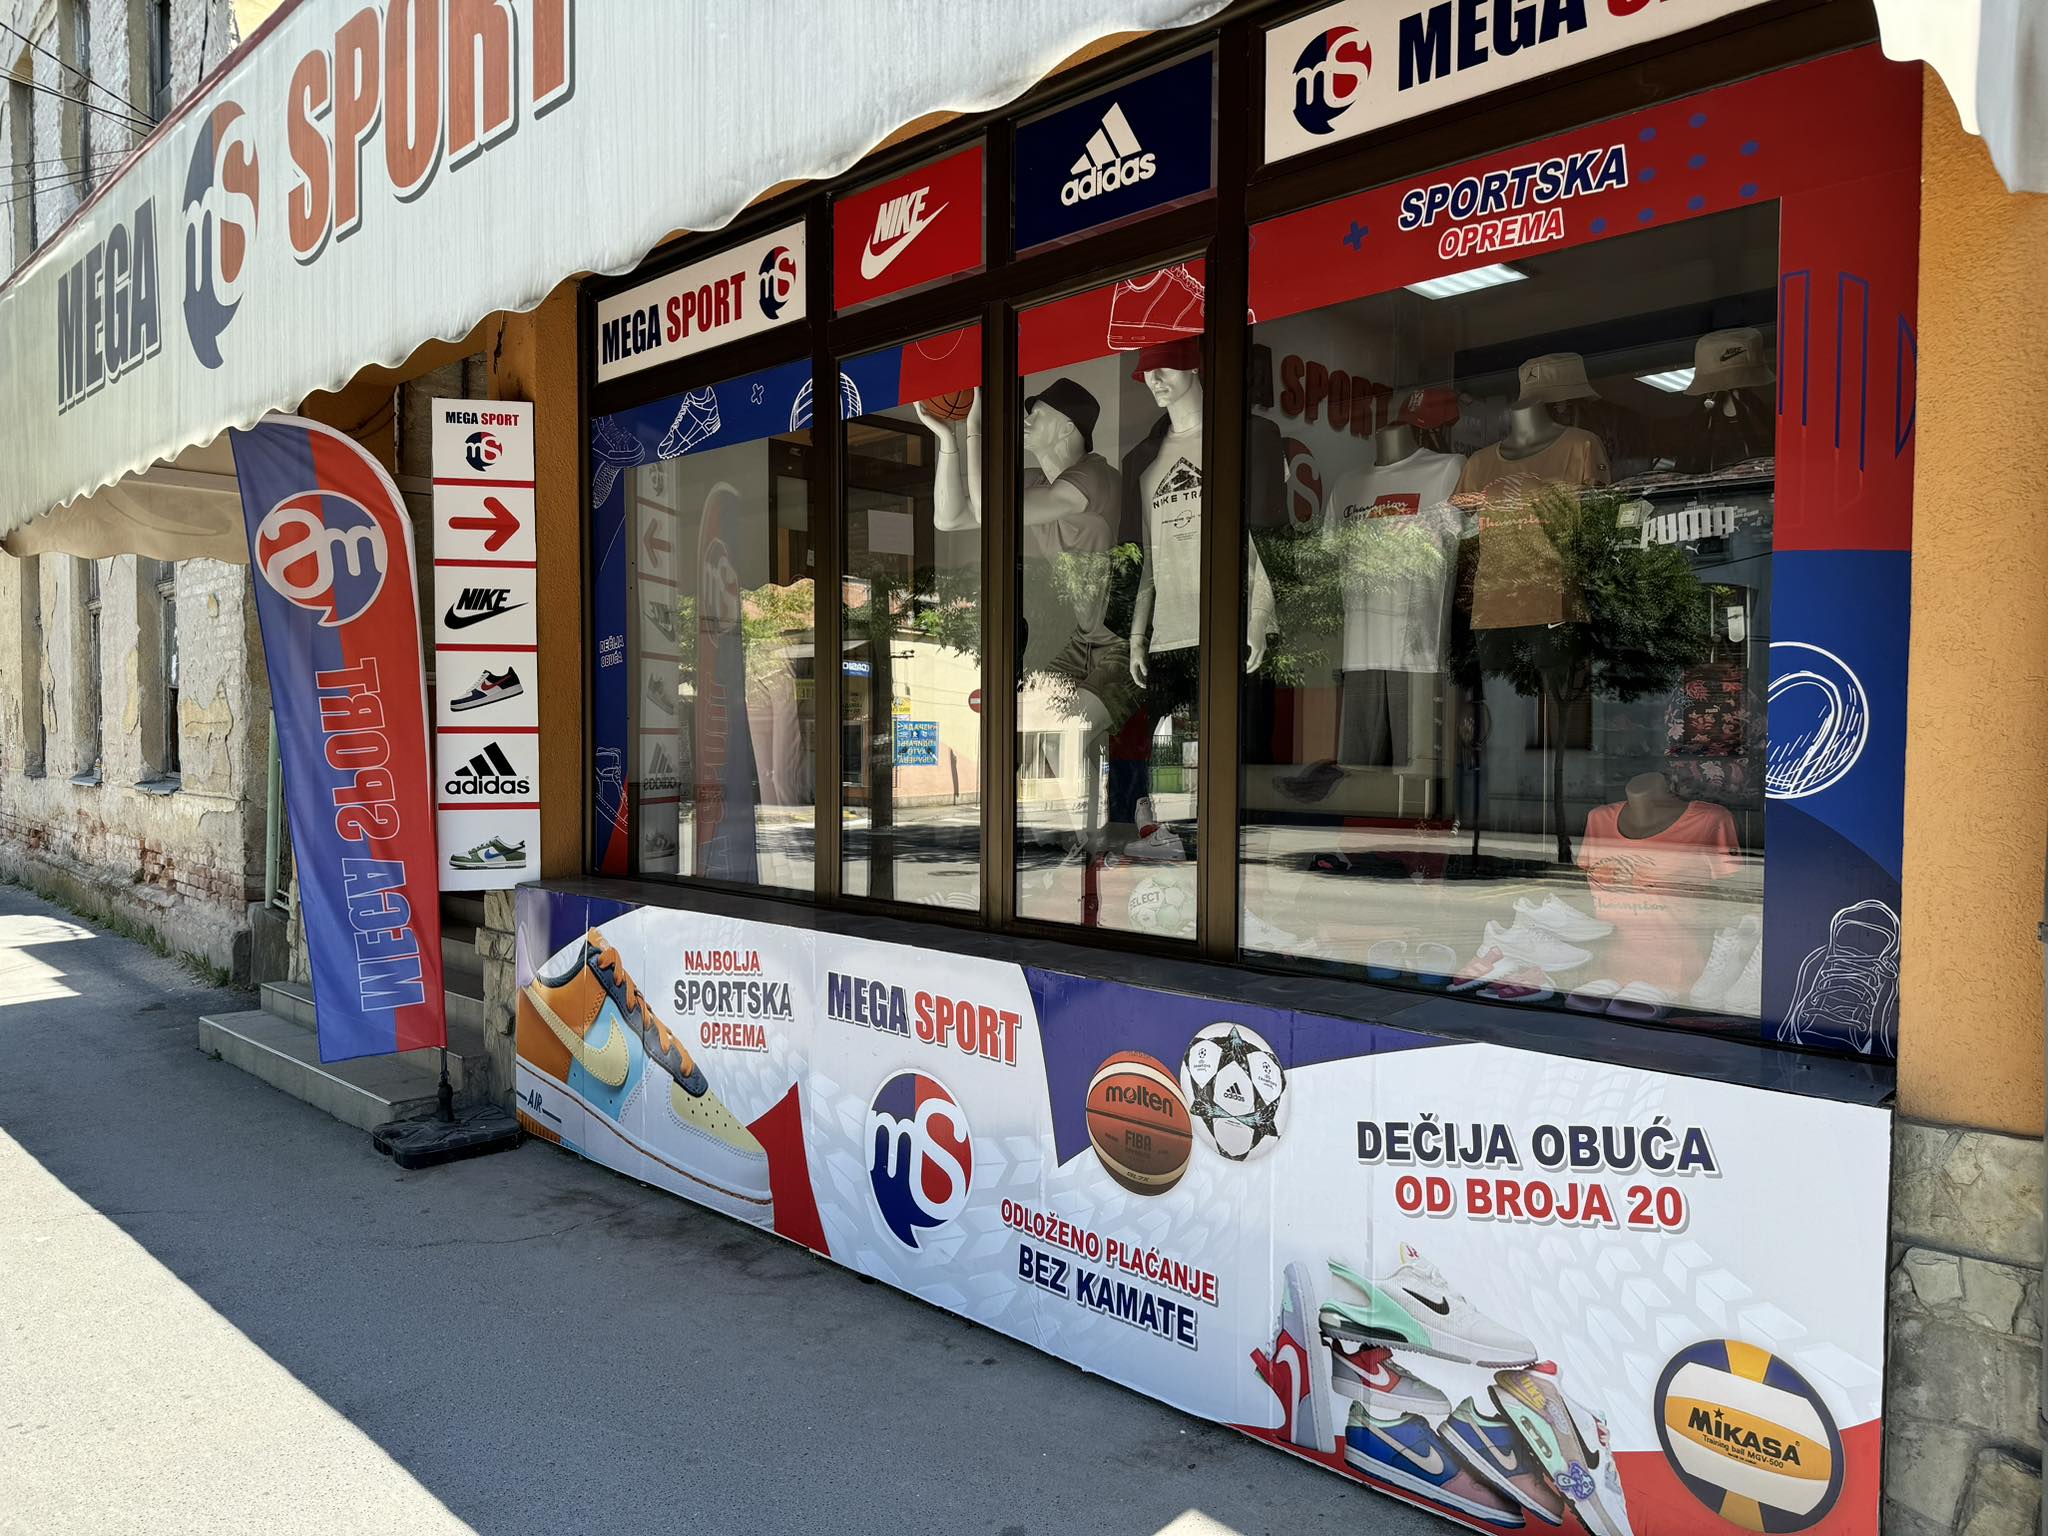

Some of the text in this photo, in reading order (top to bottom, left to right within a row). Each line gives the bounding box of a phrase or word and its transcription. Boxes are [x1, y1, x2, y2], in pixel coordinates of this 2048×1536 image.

[1061, 153, 1156, 206] adidas
[1398, 144, 1628, 231] SPORTSKA
[872, 186, 930, 245] NIKE
[1438, 208, 1564, 260] OPREMA
[58, 195, 161, 414] MEGA
[602, 303, 662, 365] MEGA
[666, 271, 746, 343] SPORT
[445, 411, 520, 427] MEGA SPORT
[1153, 494, 1178, 509] NIKE
[1343, 500, 1409, 521] Champion
[456, 588, 511, 610] NIKE
[445, 776, 530, 795] adidas
[684, 949, 762, 975] NAJBOLJA
[673, 978, 794, 1020] SPORTSKA
[827, 971, 1022, 1066] MEGA SPORT
[700, 1021, 768, 1052] OPREMA
[527, 1089, 543, 1113] AIR
[1105, 1085, 1174, 1119] molten
[1223, 1092, 1245, 1102] adidas
[1125, 1129, 1152, 1152] FIBA
[1356, 1112, 1718, 1175] DEČIJA OBUĆA
[1394, 1175, 1689, 1232] OD BROJA 20
[1001, 1198, 1217, 1305] ODLOŽENO PLAĆANJE
[1018, 1243, 1197, 1350] BEZ KAMATE
[1687, 1407, 1801, 1466] MIKASA
[1702, 1434, 1730, 1452] Training
[1731, 1444, 1745, 1456] ball
[1747, 1452, 1784, 1469] MGV-500
